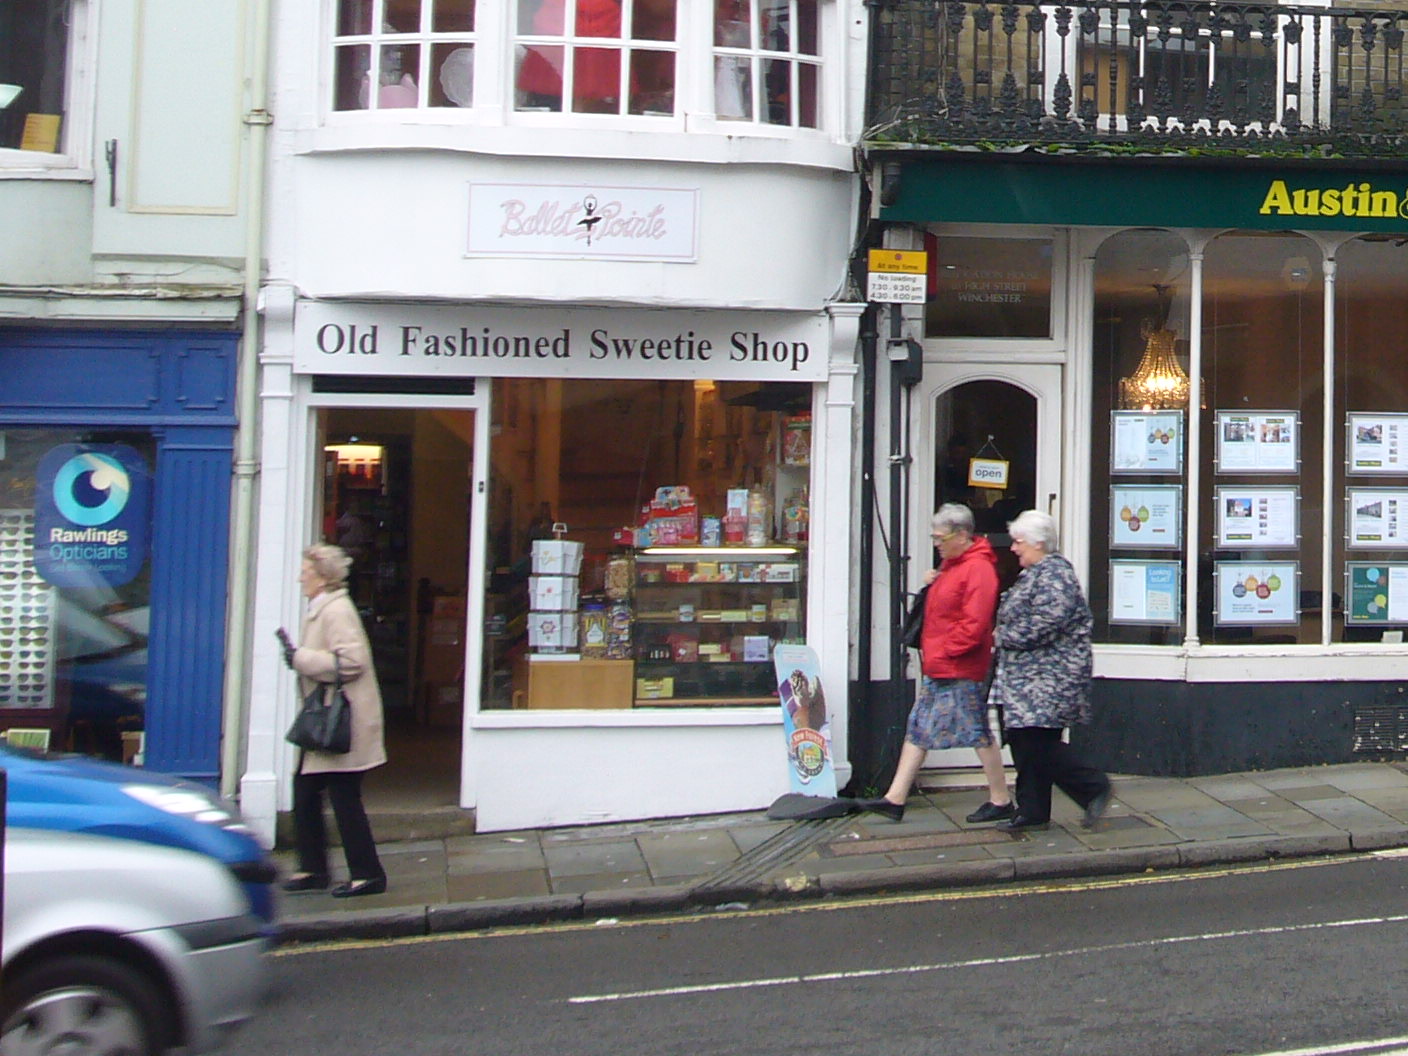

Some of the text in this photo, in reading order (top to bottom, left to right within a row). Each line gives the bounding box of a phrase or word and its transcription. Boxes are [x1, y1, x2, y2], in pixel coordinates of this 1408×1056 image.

[498, 199, 668, 240] Ballet Pointe
[958, 293, 1022, 304] WINCHESTER
[316, 323, 811, 371] Old Fashioned Sweetie Shop
[975, 468, 1003, 479] open
[50, 527, 129, 546] Rawlings
[49, 543, 128, 563] Opticians
